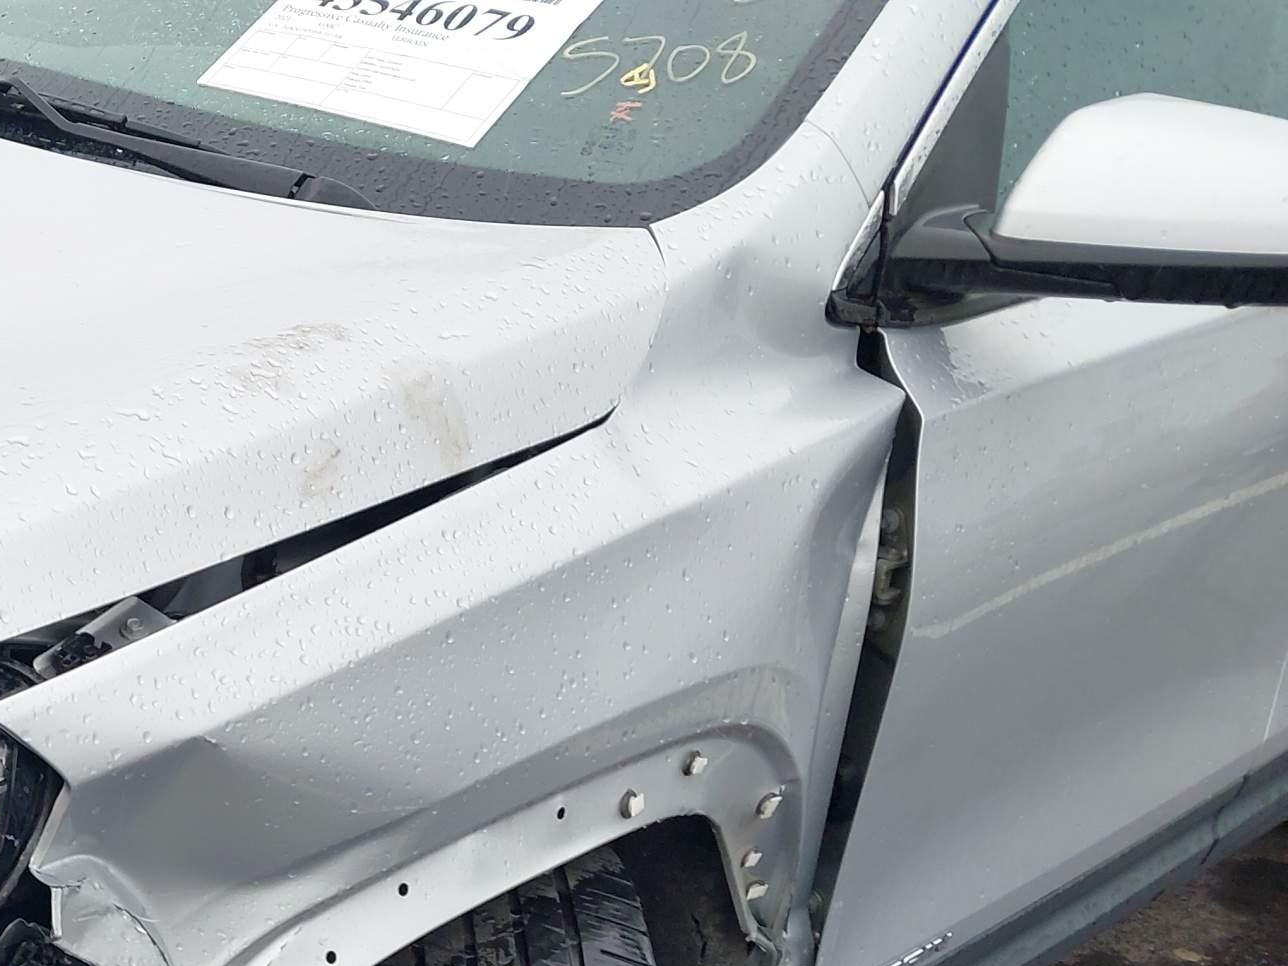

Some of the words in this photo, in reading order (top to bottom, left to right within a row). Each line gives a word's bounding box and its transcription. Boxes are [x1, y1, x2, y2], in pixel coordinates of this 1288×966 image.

[283, 4, 344, 21] Progressive
[345, 15, 390, 31] Casualty
[395, 23, 450, 41] Insurance
